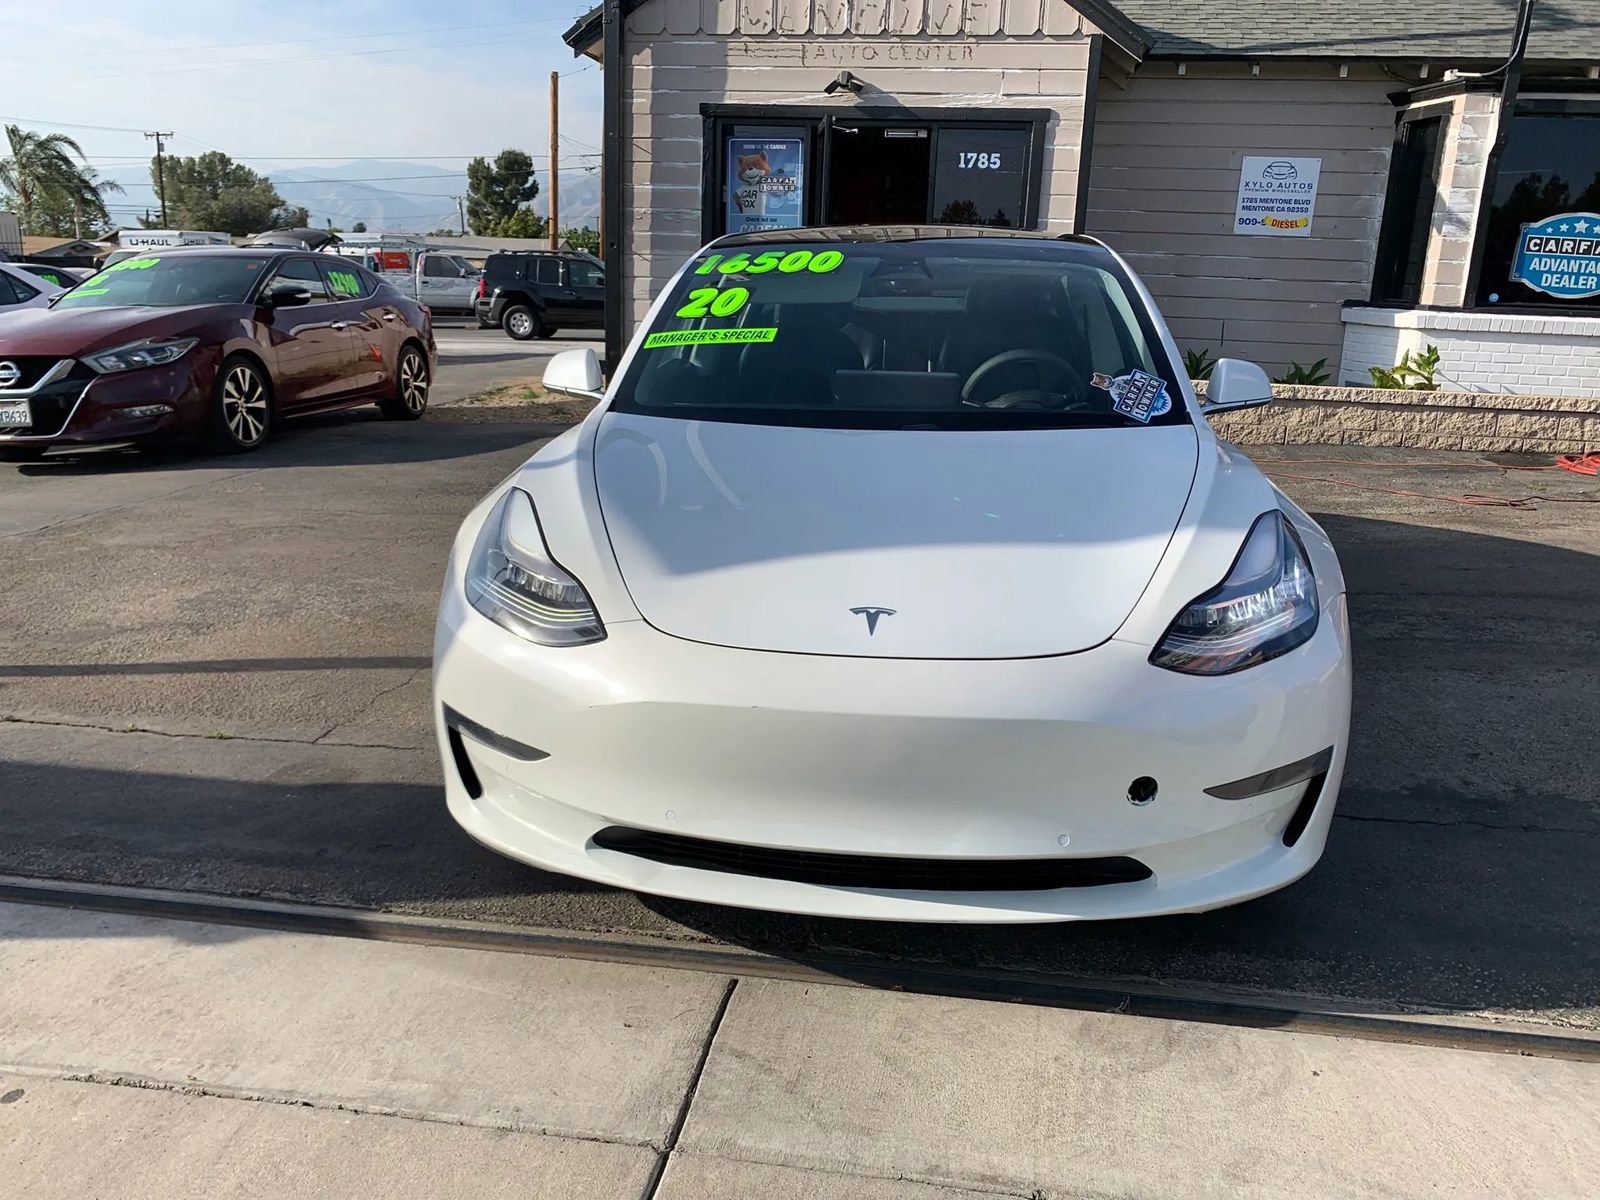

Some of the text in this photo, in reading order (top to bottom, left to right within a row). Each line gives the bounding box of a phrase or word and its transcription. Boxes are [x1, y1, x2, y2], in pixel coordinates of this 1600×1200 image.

[888, 45, 975, 61] CENTER
[958, 152, 1000, 169] 1785
[1244, 181, 1314, 190] XYLO AUTOS
[742, 190, 758, 200] CAR
[1241, 205, 1275, 213] MENTONE
[1270, 218, 1301, 229] DIESEL
[129, 238, 172, 246] U-HAUL
[1529, 238, 1600, 255] CARF
[694, 250, 845, 275] 16500
[1529, 257, 1600, 273] ADVANTA
[1541, 273, 1598, 290] DEALER
[675, 286, 750, 318] 20
[651, 329, 770, 346] MANAGER'S SPECIAL
[1120, 374, 1150, 412] CARFAX
[0, 410, 28, 424] B639
